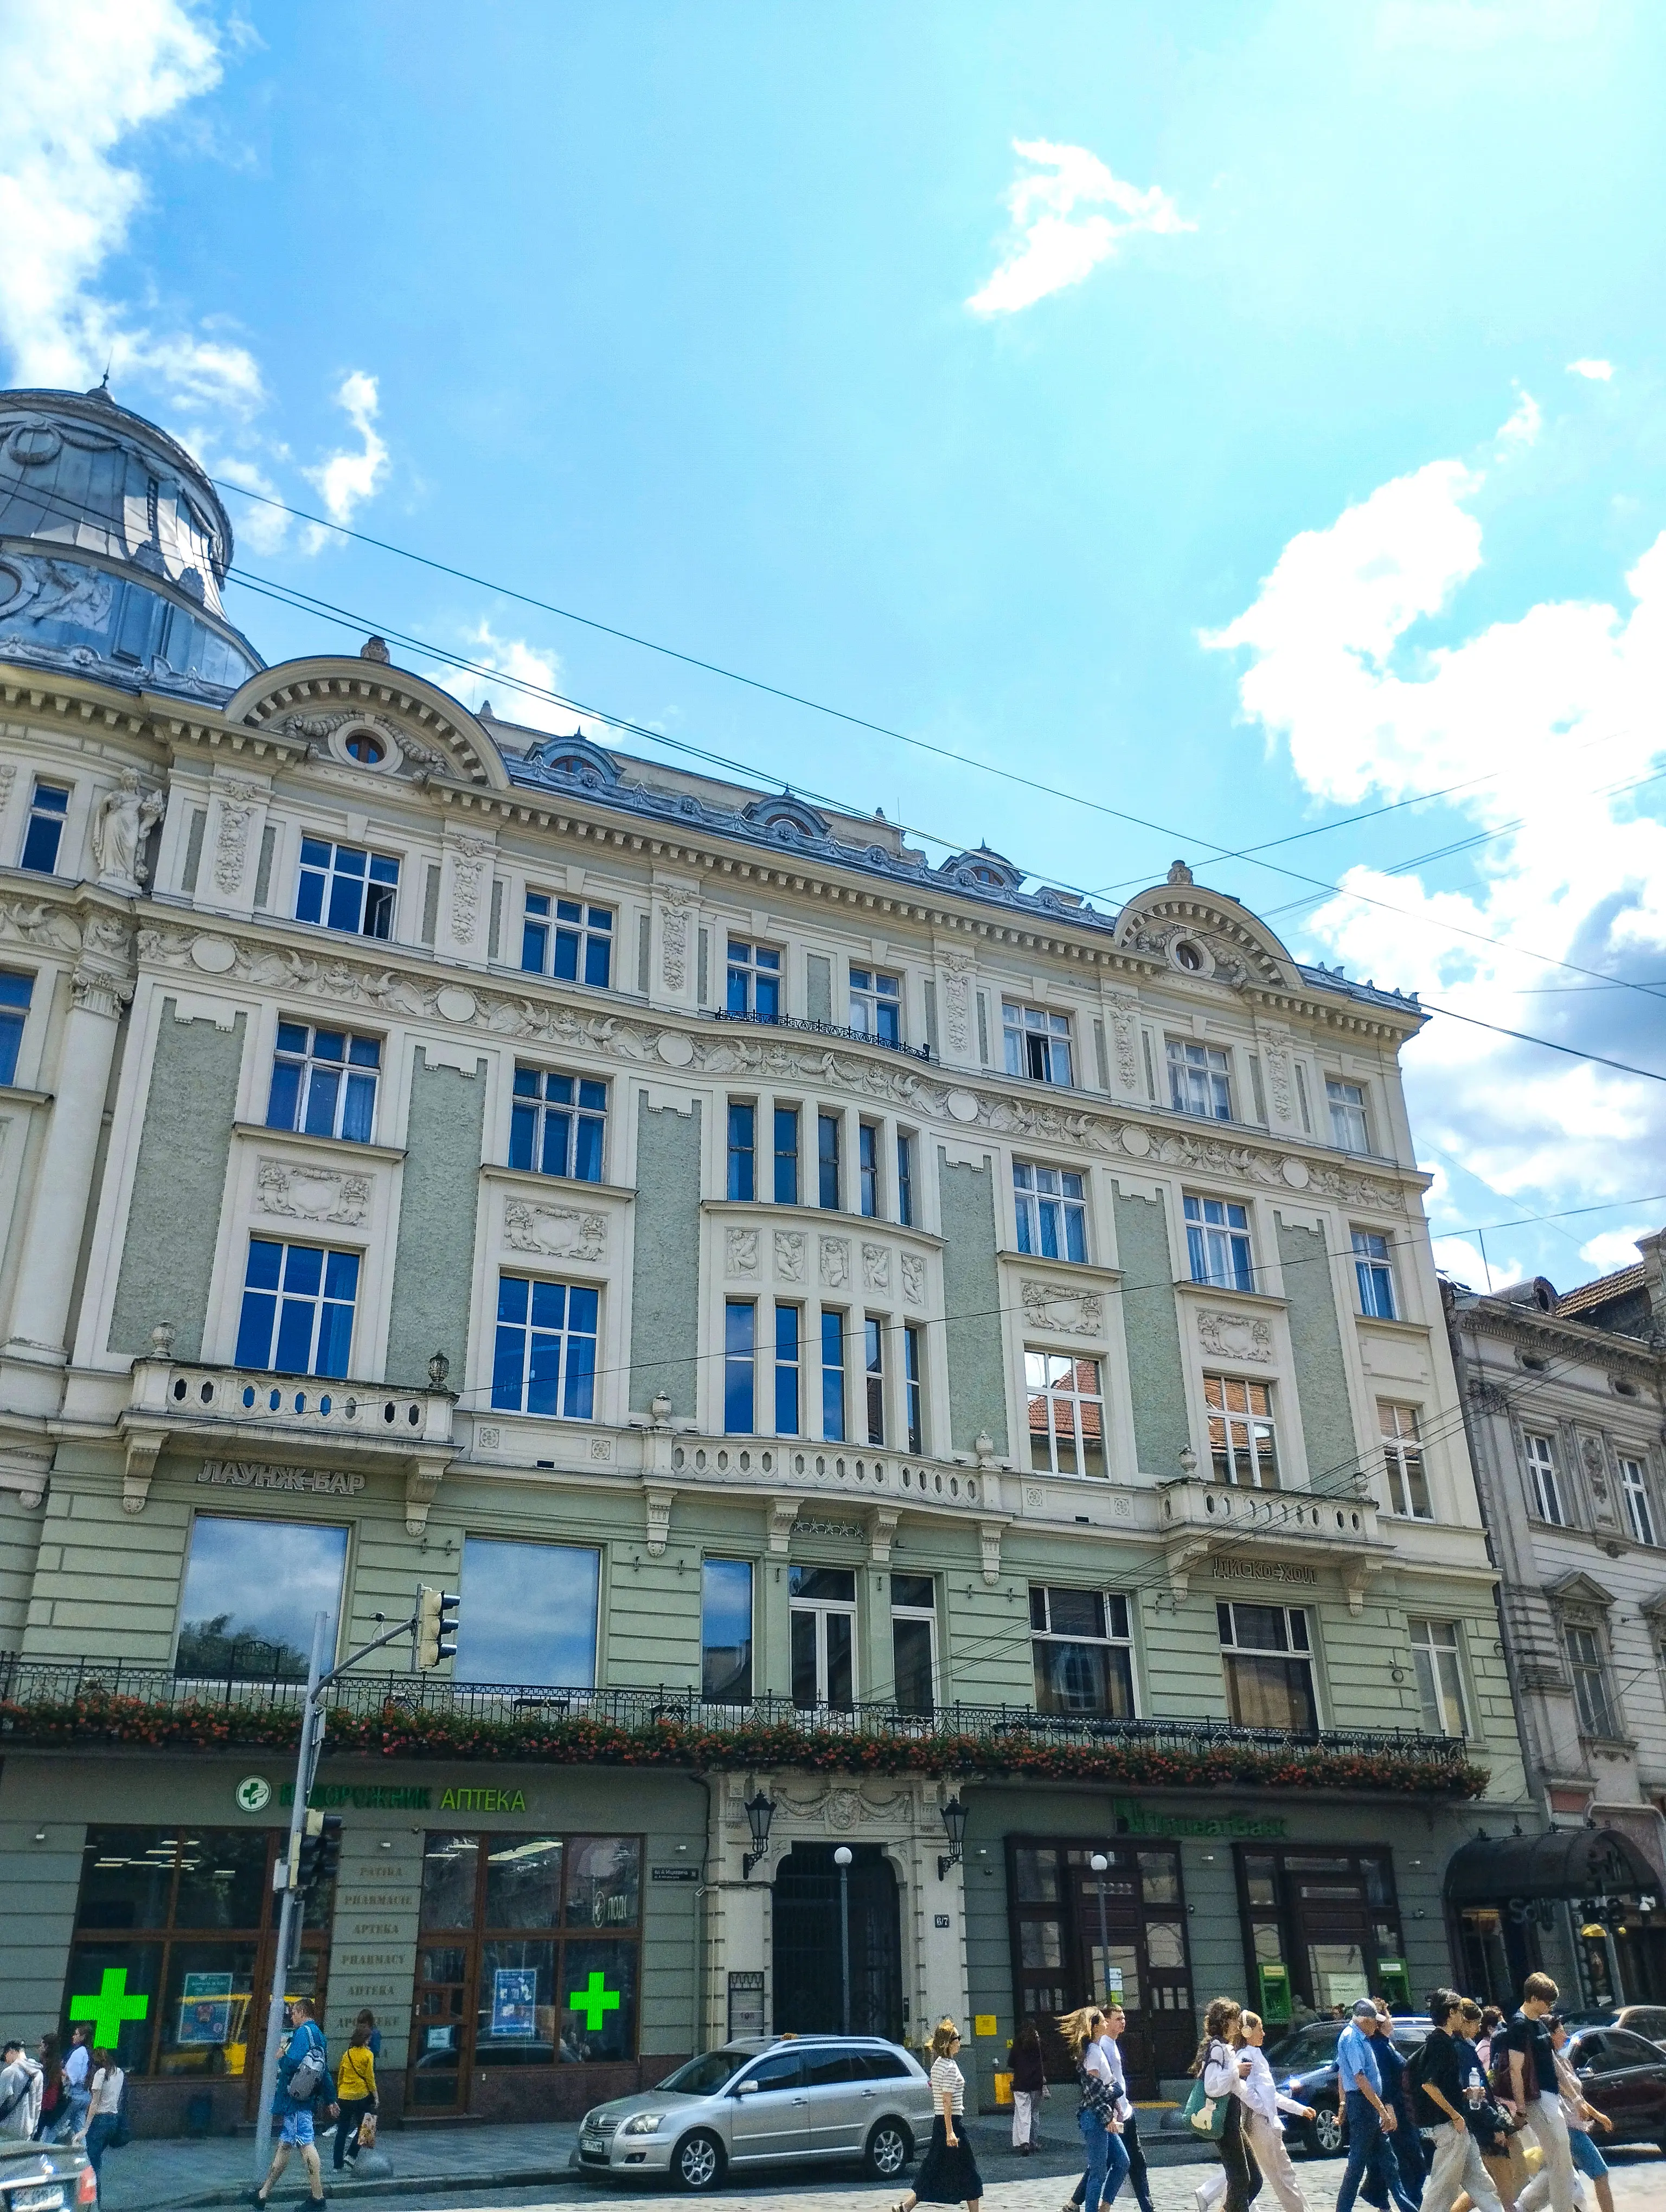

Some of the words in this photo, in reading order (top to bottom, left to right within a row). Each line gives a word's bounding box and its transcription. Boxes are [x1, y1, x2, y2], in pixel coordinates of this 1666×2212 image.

[197, 1459, 366, 1495] ЛАУНЖ-БАР
[1214, 1557, 1317, 1584] ДИСКО-ХОЛ
[440, 1788, 526, 1812] АПТЕКА
[936, 1917, 948, 1926] 6/7
[341, 1954, 406, 1965] PHARMACY
